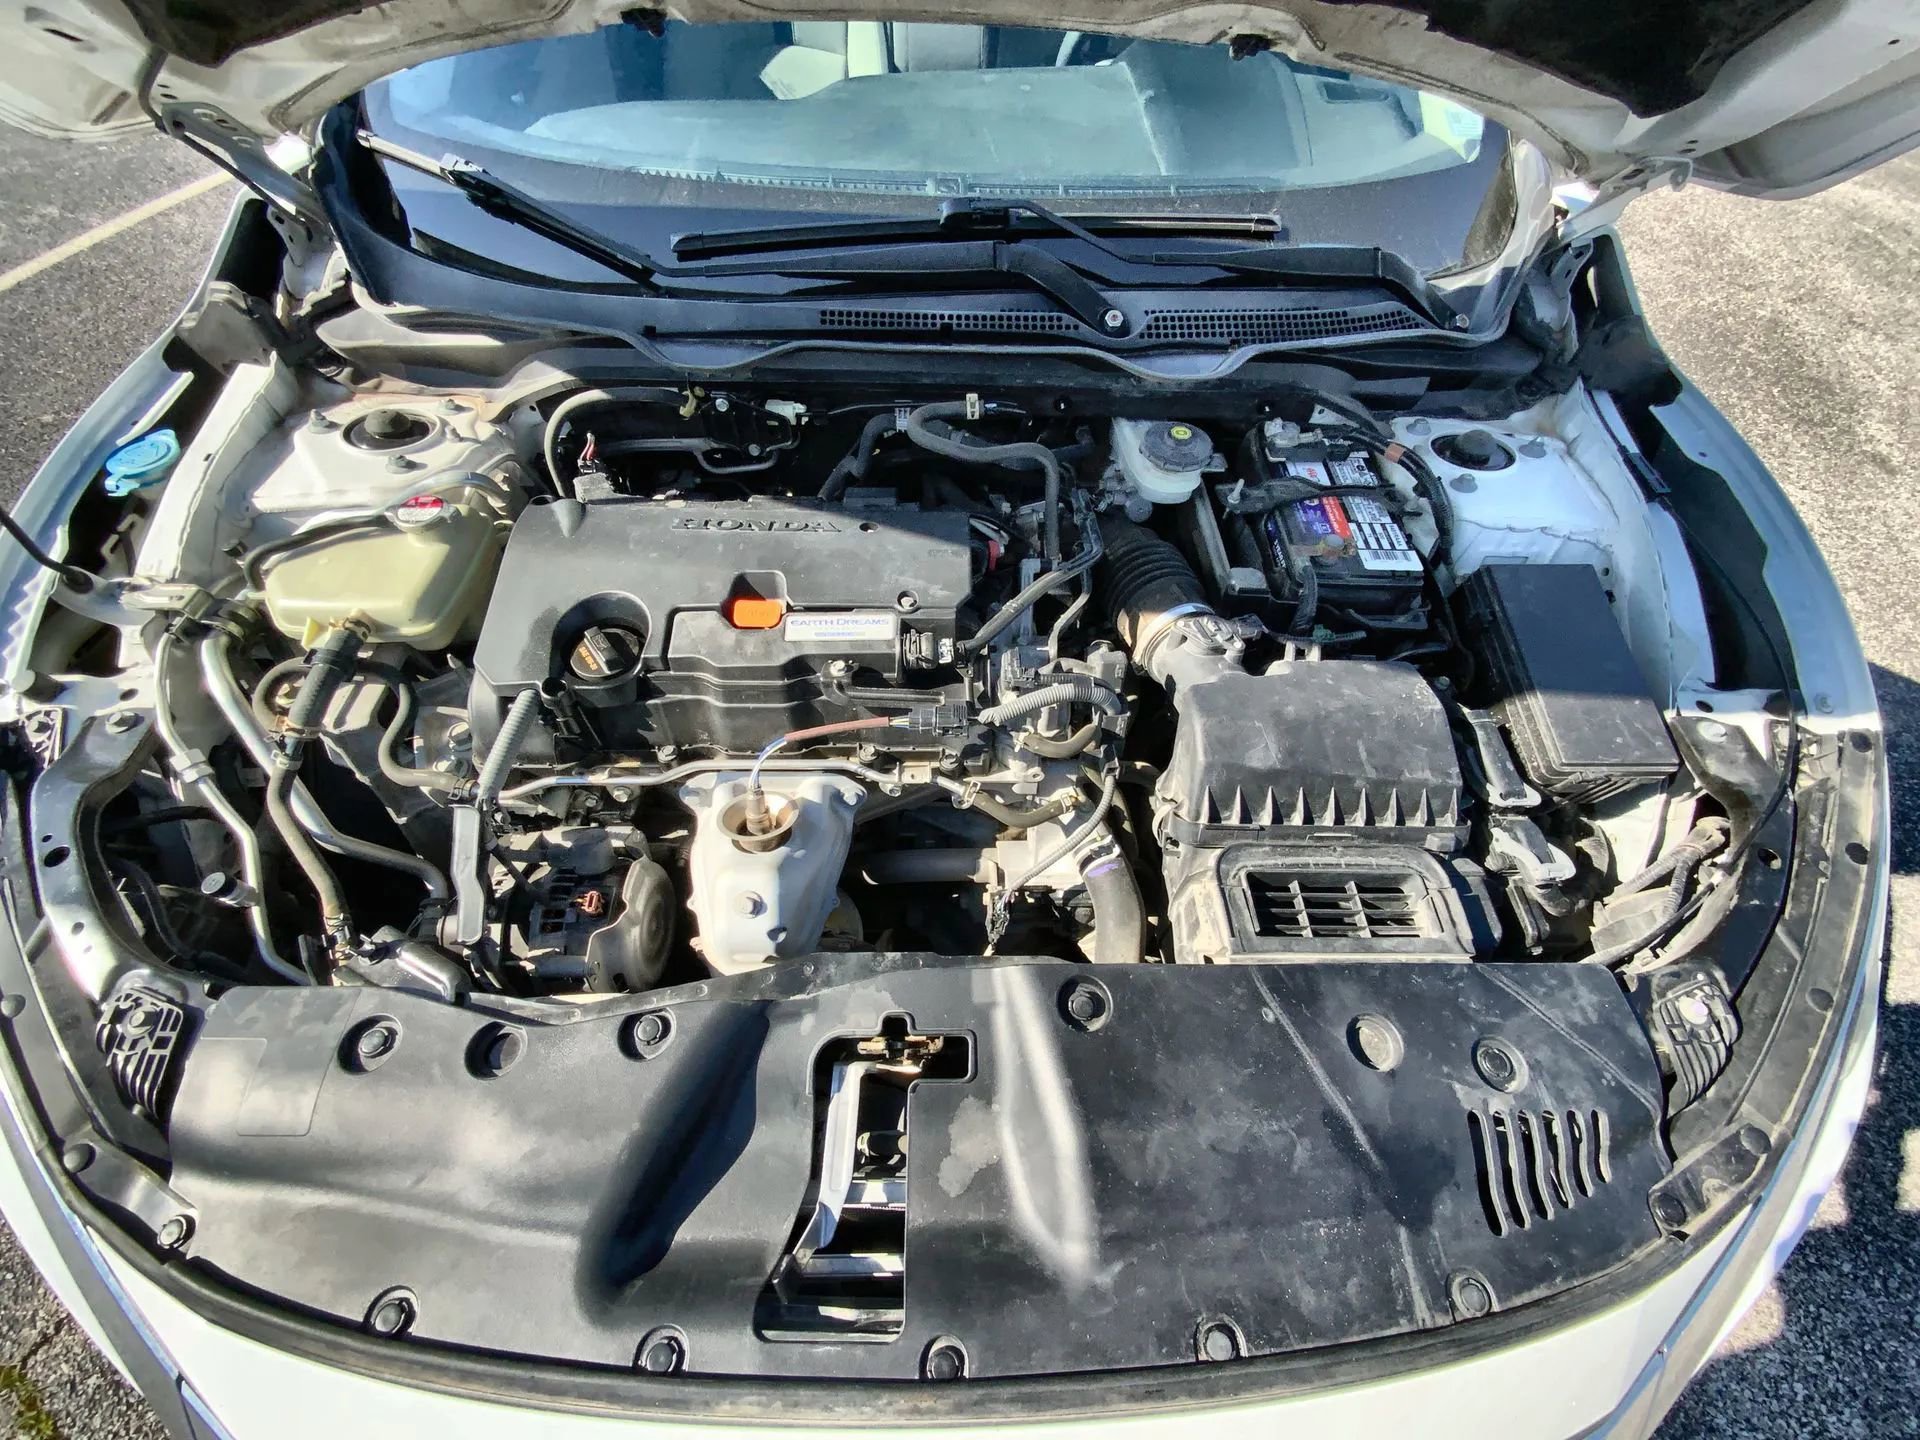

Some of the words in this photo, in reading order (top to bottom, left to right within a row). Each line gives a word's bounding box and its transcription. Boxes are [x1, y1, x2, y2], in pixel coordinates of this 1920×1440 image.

[671, 517, 842, 533] HONDA
[790, 618, 834, 626] EARTH
[836, 618, 889, 626] DREAMS
